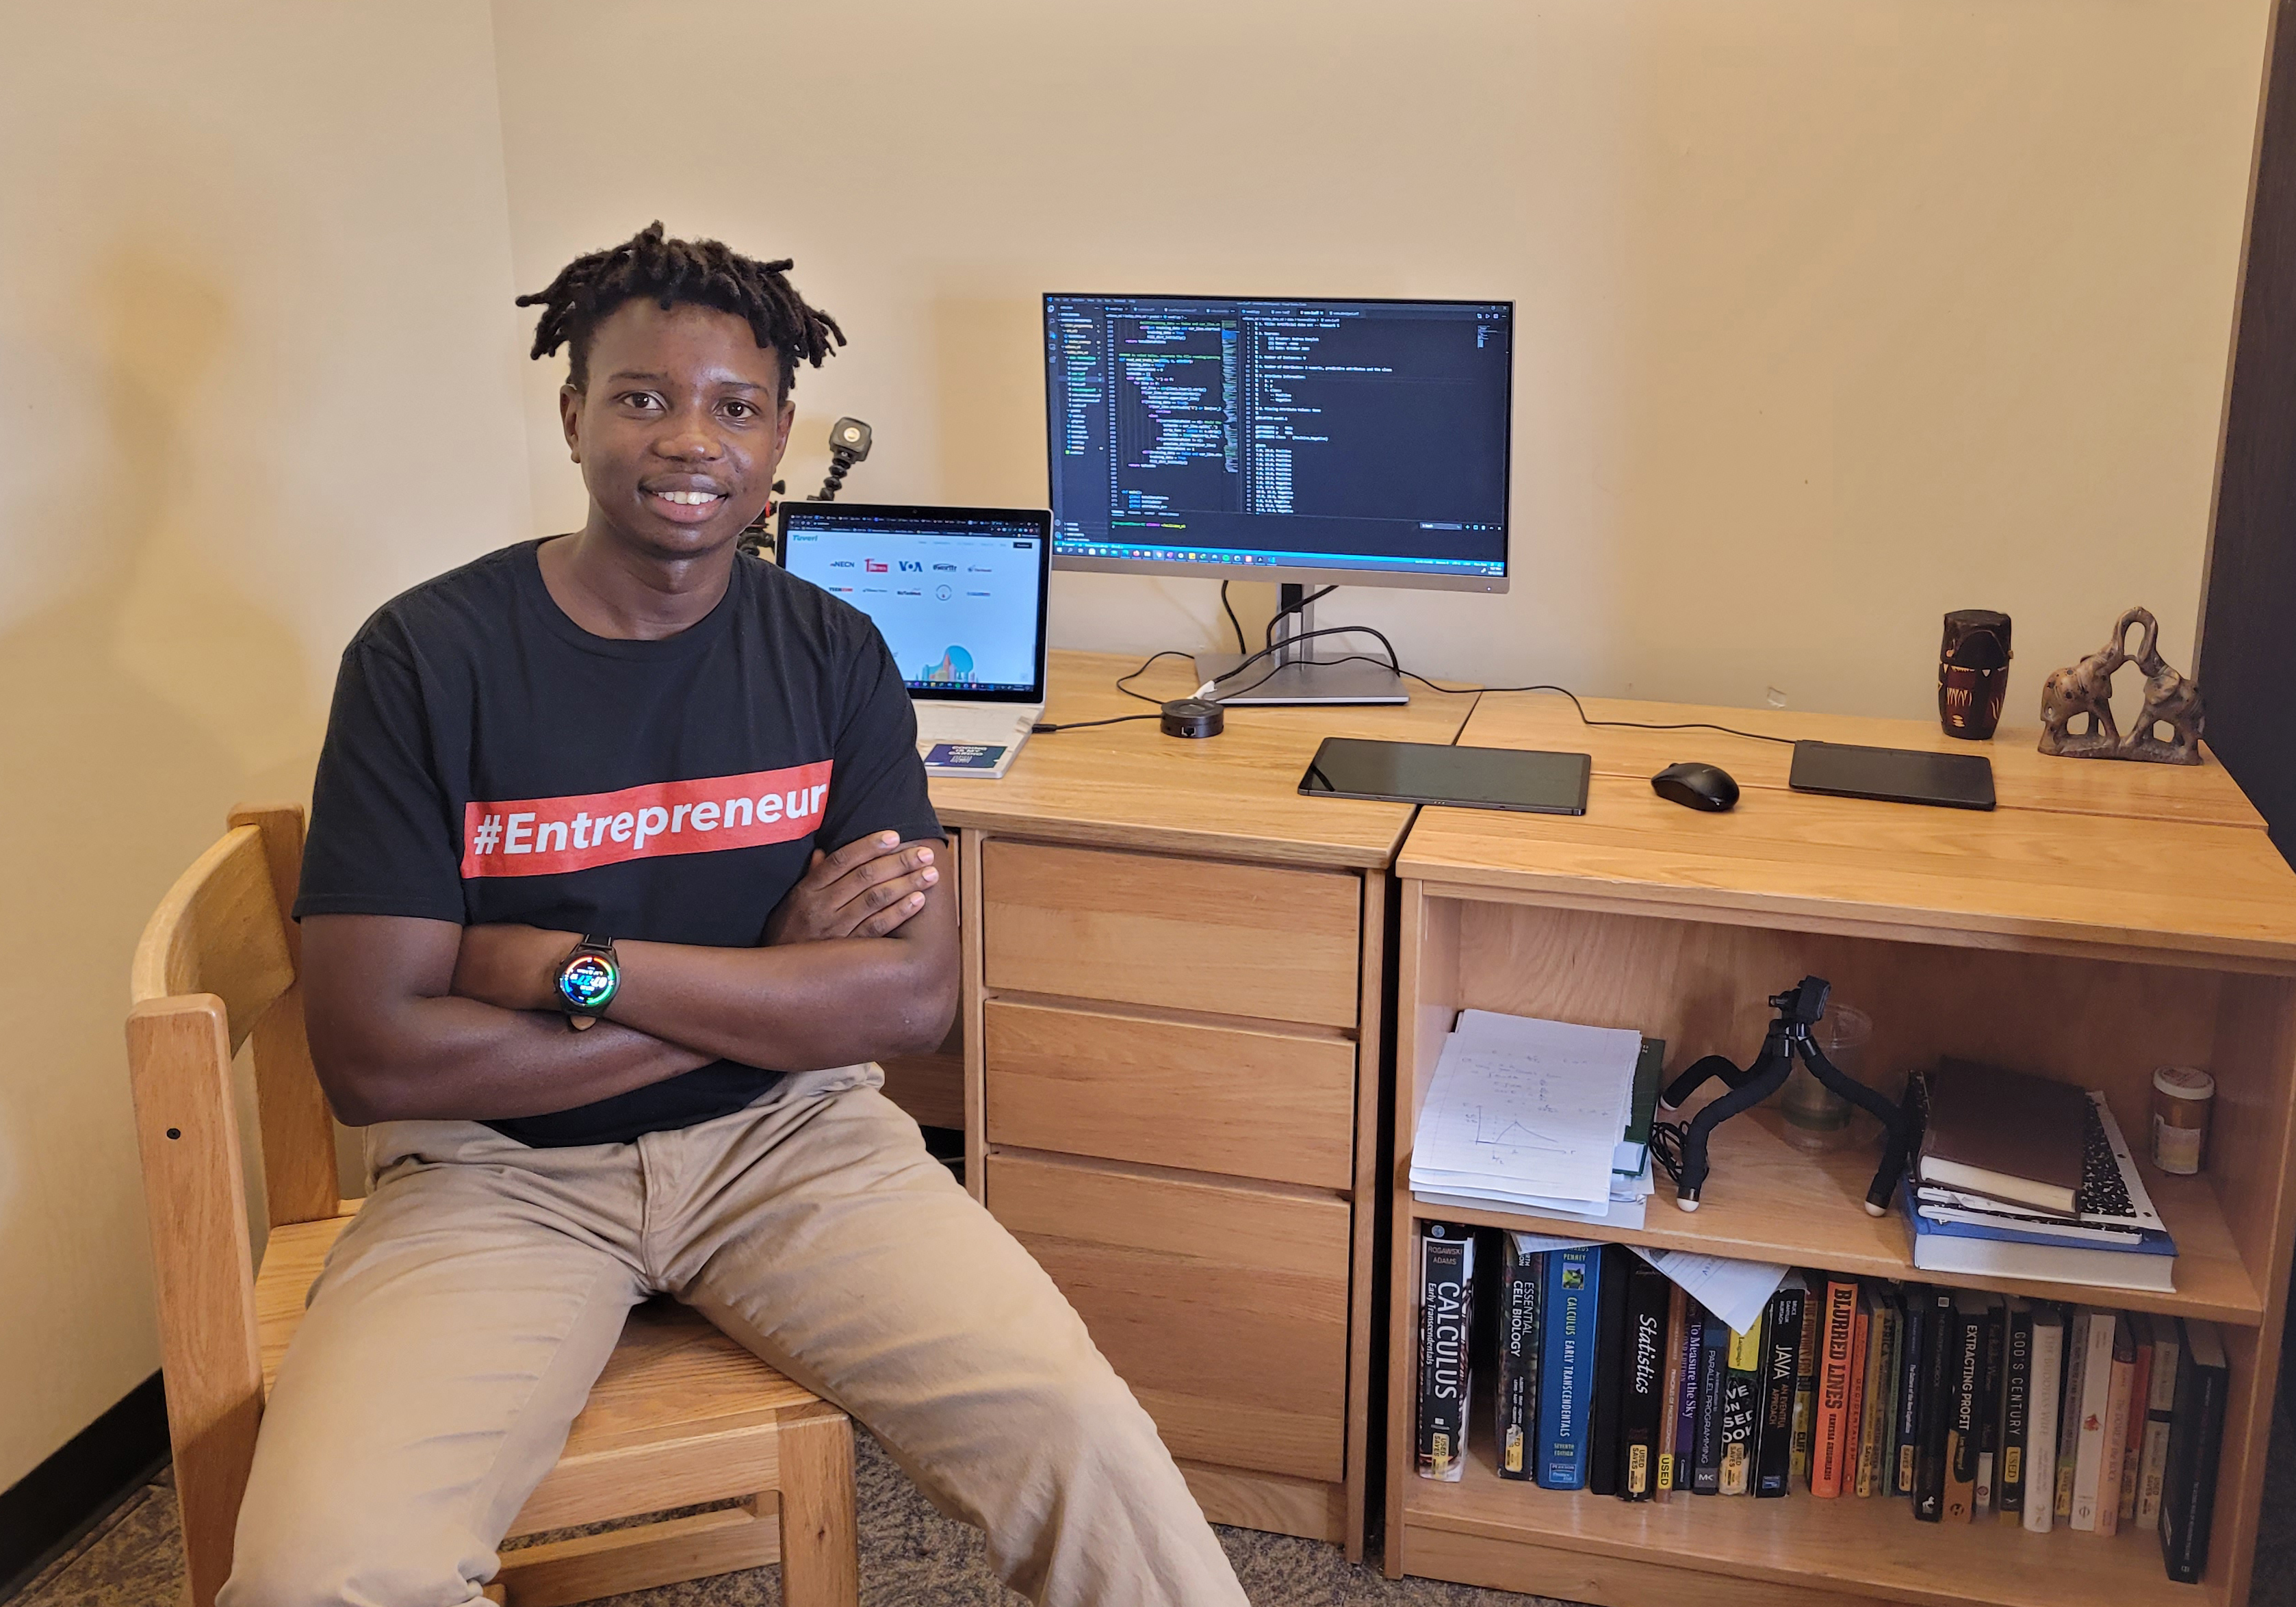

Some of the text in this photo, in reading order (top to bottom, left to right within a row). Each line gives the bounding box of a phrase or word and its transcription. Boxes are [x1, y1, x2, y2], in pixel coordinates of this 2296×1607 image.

[473, 782, 827, 855] #Entrepreneur
[1433, 1257, 1456, 1265] ADAMS
[1426, 1283, 1436, 1365] Early Transcendentals
[1510, 1281, 1523, 1357] CELL BIOLOGY
[1522, 1282, 1534, 1335] ESSENTIAL
[1829, 1289, 1853, 1359] BLURRED
[1881, 1317, 1893, 1357] AFRICA
[1435, 1282, 1460, 1398] CALCULUS
[1560, 1297, 1577, 1437] CALCULUS EARLY TRANSCENDENTALS
[1636, 1314, 1657, 1394] Statistics
[1772, 1344, 1793, 1380] JAVA
[1961, 1325, 1978, 1391] EXTRACTING
[1681, 1323, 1702, 1419] To Measure the Sky
[1825, 1363, 1849, 1409] LINES
[2009, 1332, 2026, 1435] GOD'S CENTURY
[1701, 1350, 1716, 1463] PARALLEL PROGRAMMING
[1770, 1389, 1780, 1424] APPROACH
[1777, 1384, 1788, 1428] AN EVENTFUL
[1828, 1413, 1837, 1440] VANESSA
[1958, 1393, 1972, 1431] PROFIT
[1661, 1457, 1670, 1485] USED
[2008, 1451, 2019, 1478] USED
